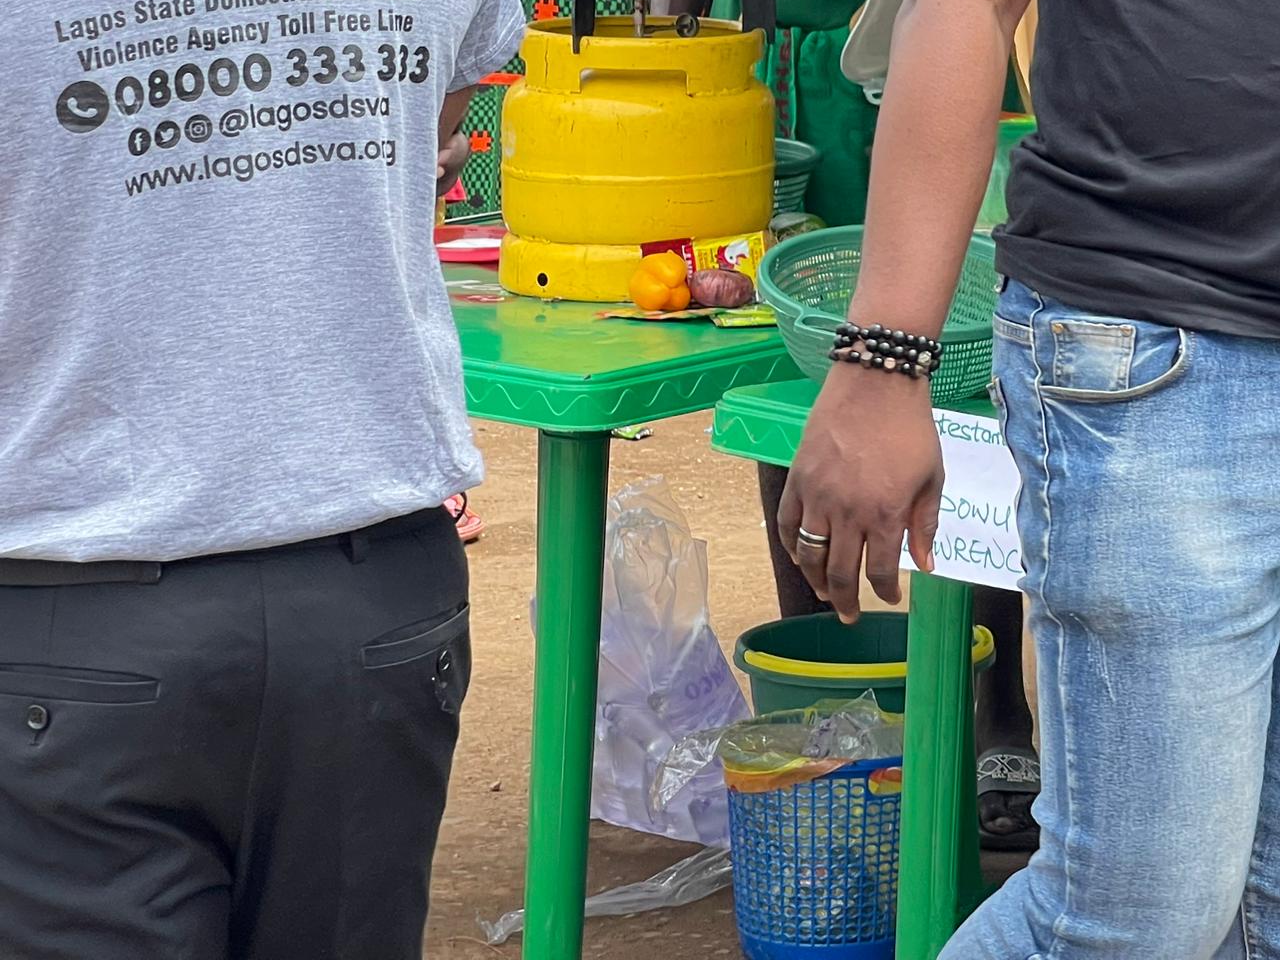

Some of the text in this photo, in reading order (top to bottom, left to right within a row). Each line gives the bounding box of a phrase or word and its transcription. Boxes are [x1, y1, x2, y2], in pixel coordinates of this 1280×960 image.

[55, 9, 127, 43] Lagos
[77, 8, 414, 72] Violence Agency Toll Free Line
[114, 53, 272, 116] 08000
[285, 44, 366, 87] 333
[218, 93, 390, 138] @lagosdsva
